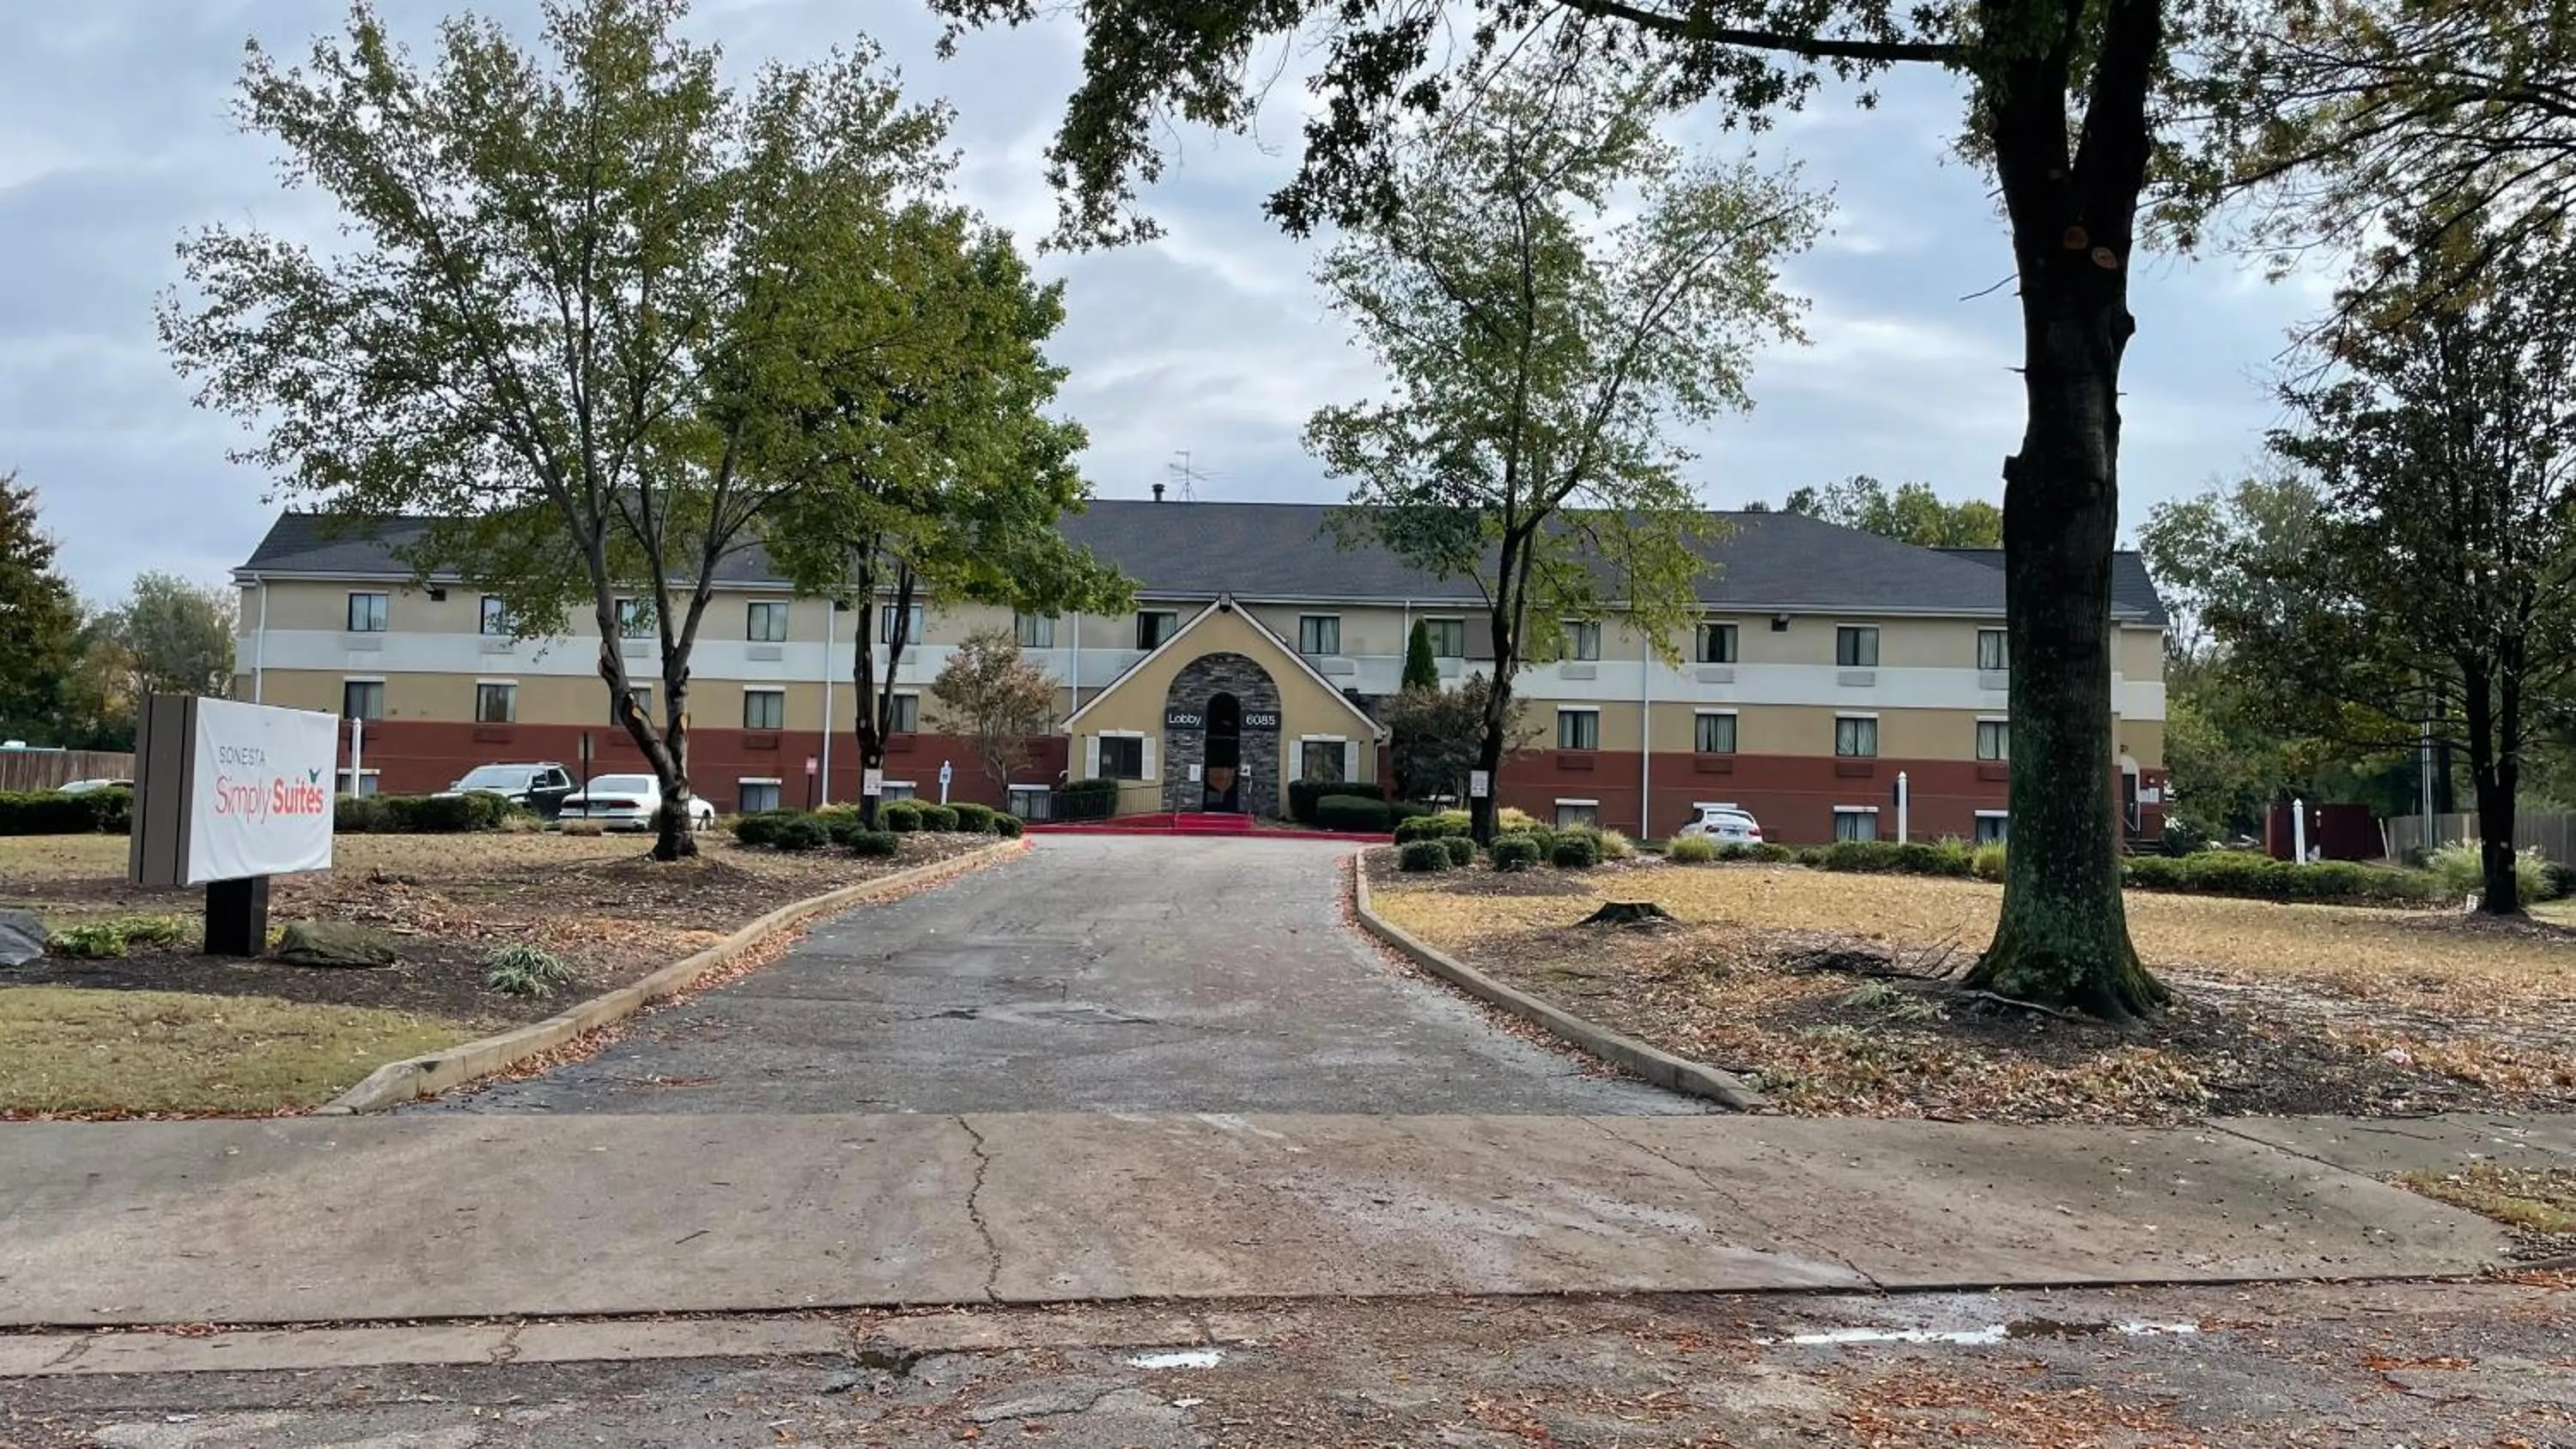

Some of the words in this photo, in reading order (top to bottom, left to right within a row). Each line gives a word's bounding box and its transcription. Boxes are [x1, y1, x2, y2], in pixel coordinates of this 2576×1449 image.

[1168, 713, 1201, 726] Lobby
[1246, 713, 1276, 725] 6085
[219, 746, 266, 766] SONESTA
[215, 774, 272, 824] Simply
[273, 775, 324, 814] Suites
